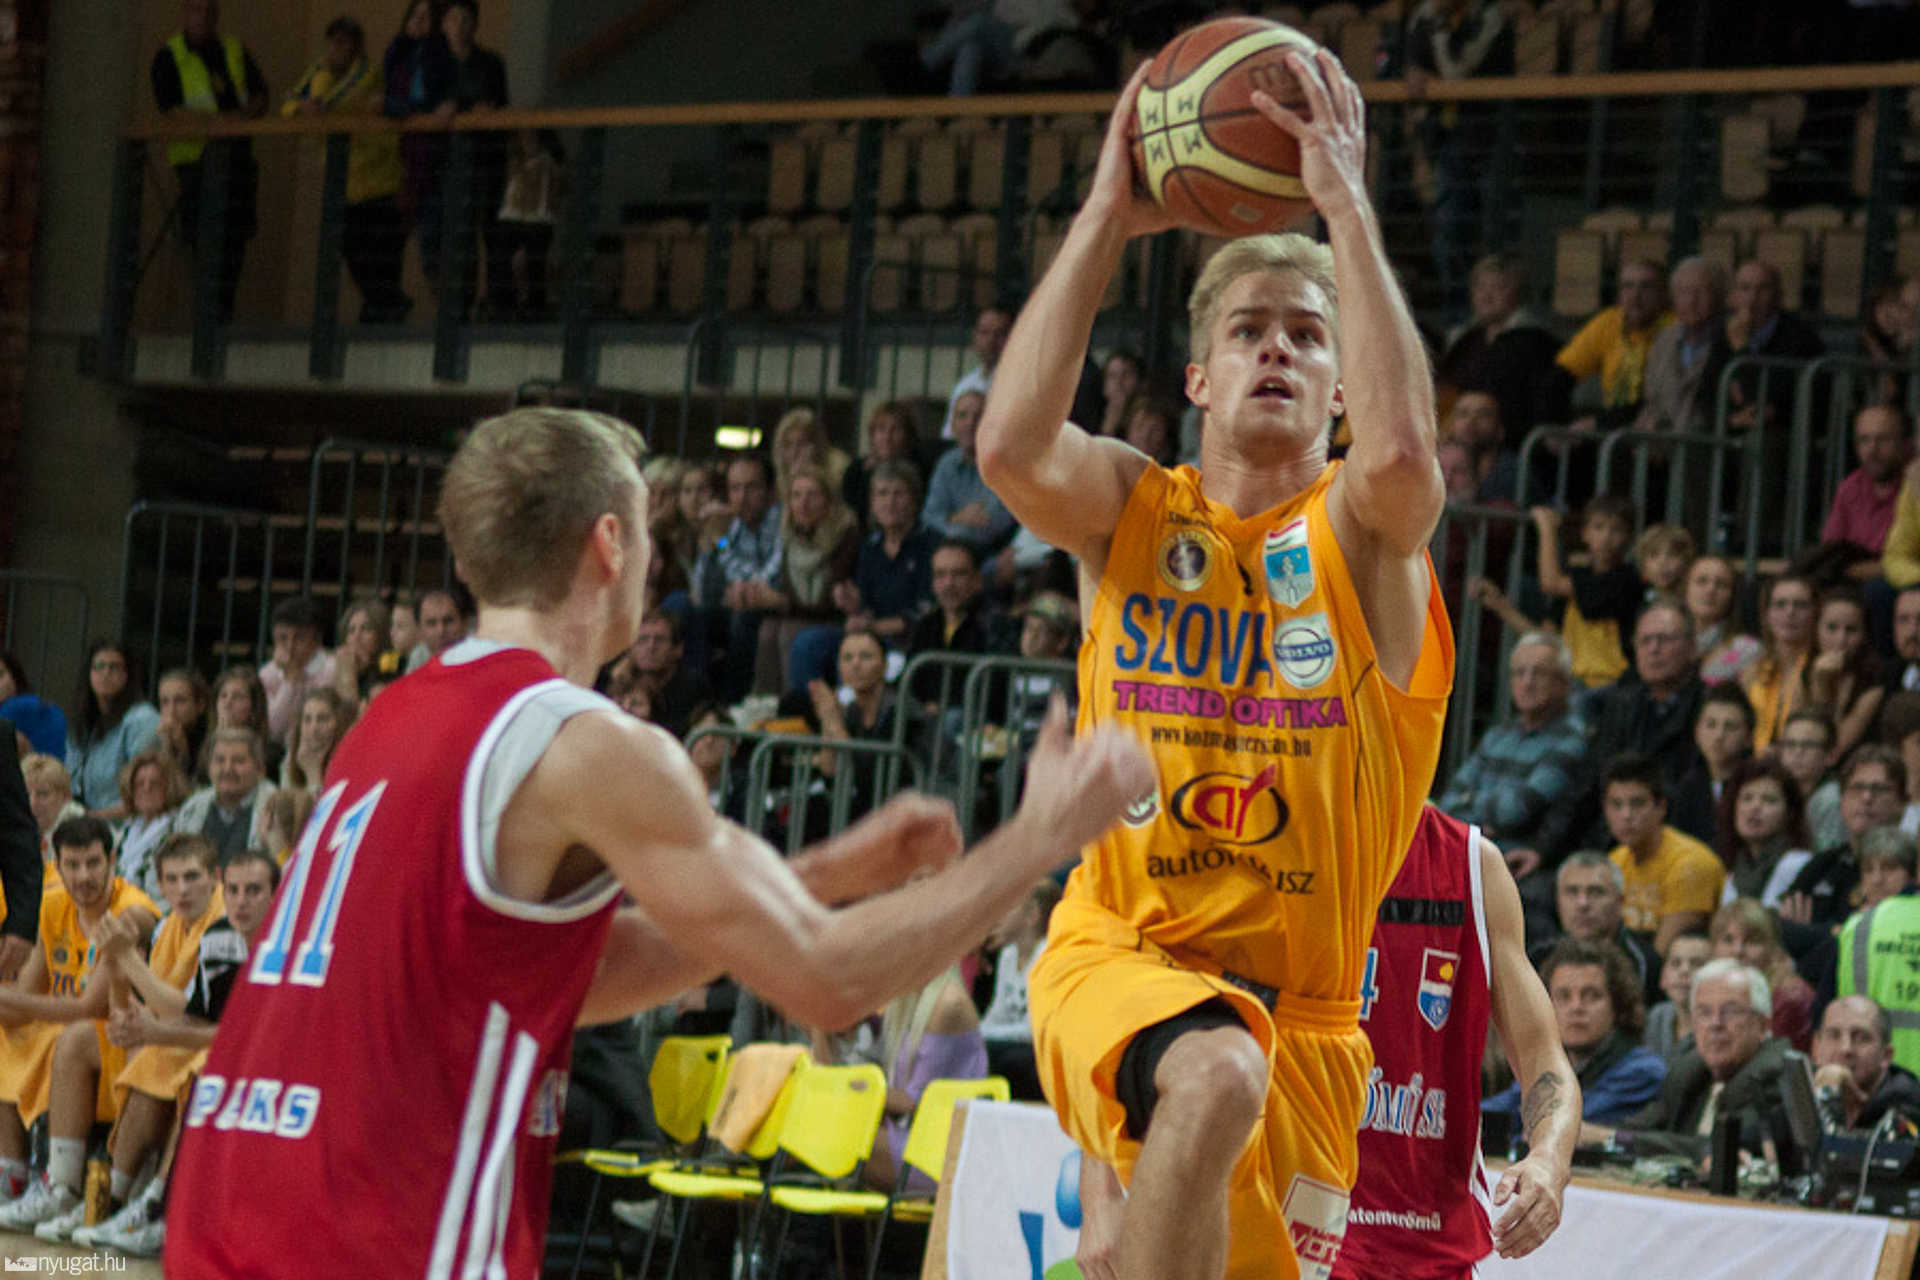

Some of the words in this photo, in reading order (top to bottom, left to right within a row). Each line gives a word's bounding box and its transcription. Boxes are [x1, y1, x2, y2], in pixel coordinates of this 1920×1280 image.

[1115, 593, 1274, 688] SZOVA
[1113, 680, 1226, 718] TREND
[248, 779, 389, 988] 11
